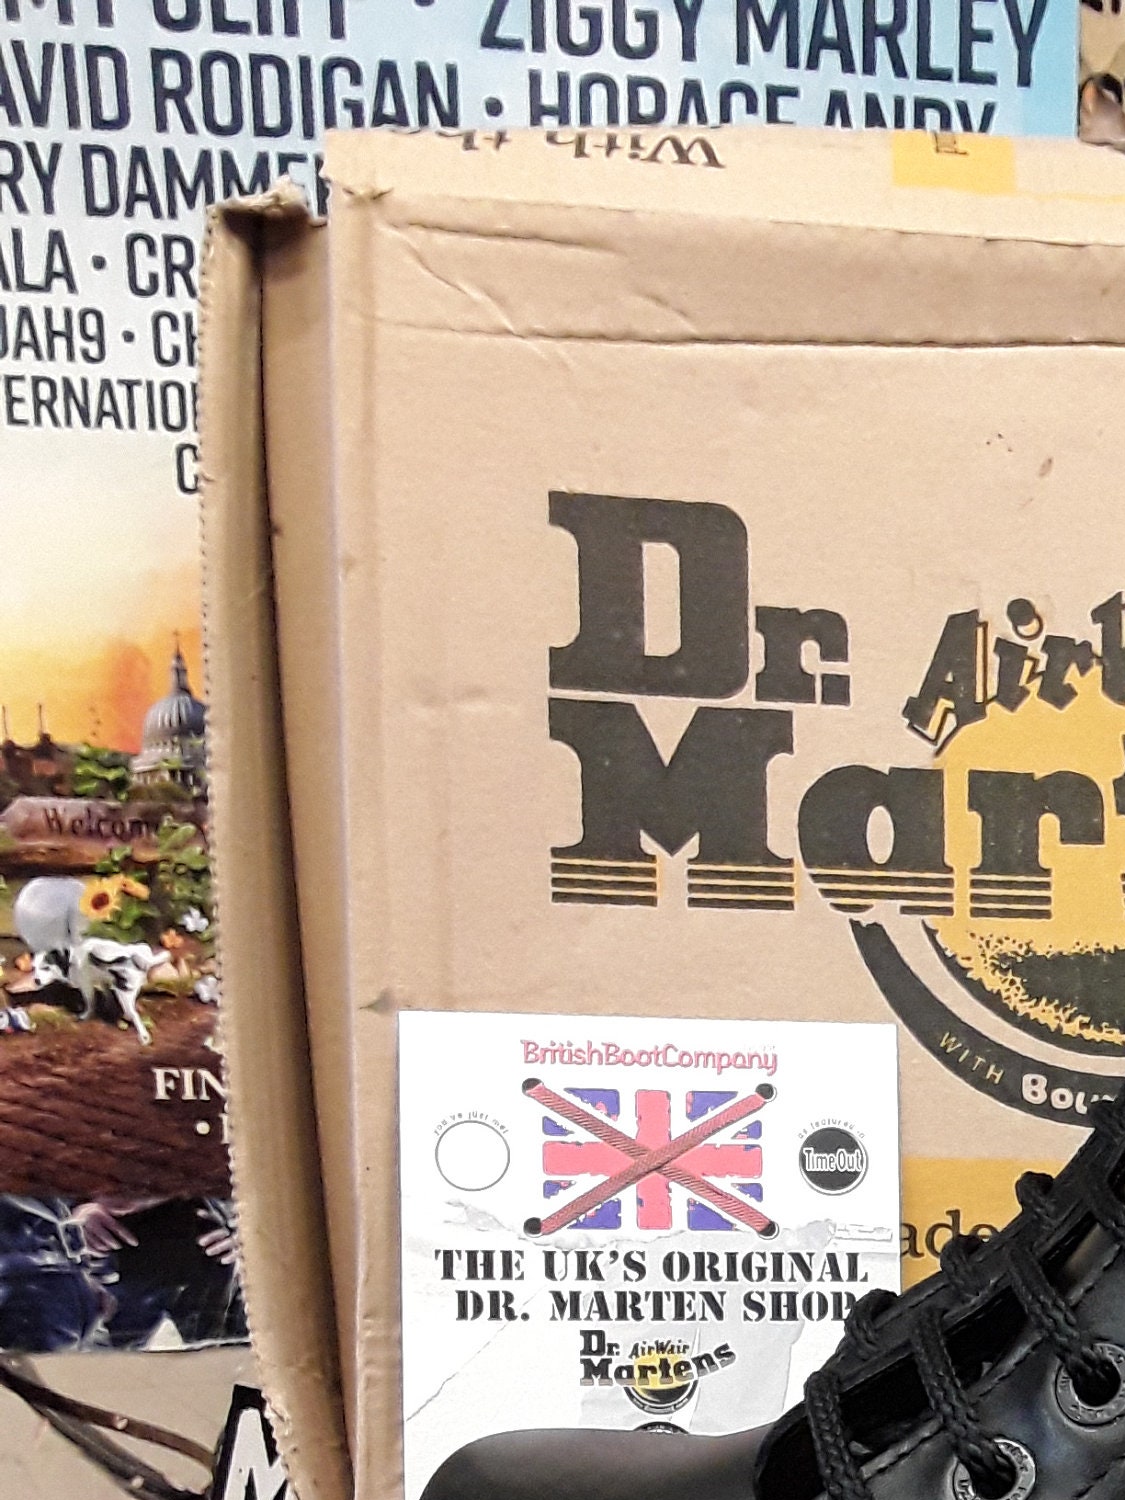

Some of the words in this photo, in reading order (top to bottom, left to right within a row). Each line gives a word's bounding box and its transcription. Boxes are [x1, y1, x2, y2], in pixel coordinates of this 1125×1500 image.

[736, 0, 1047, 88] MARLEY
[150, 47, 459, 140] RODIGAN
[938, 1031, 1006, 1086] WITH
[434, 1248, 526, 1281] THE
[542, 1249, 648, 1283] UK'S
[661, 1249, 869, 1283] ORIGINAL
[454, 1289, 530, 1322] DR.
[549, 1289, 727, 1323] MARTEN
[742, 1290, 855, 1323] SHOP
[579, 1342, 737, 1386] Martens
